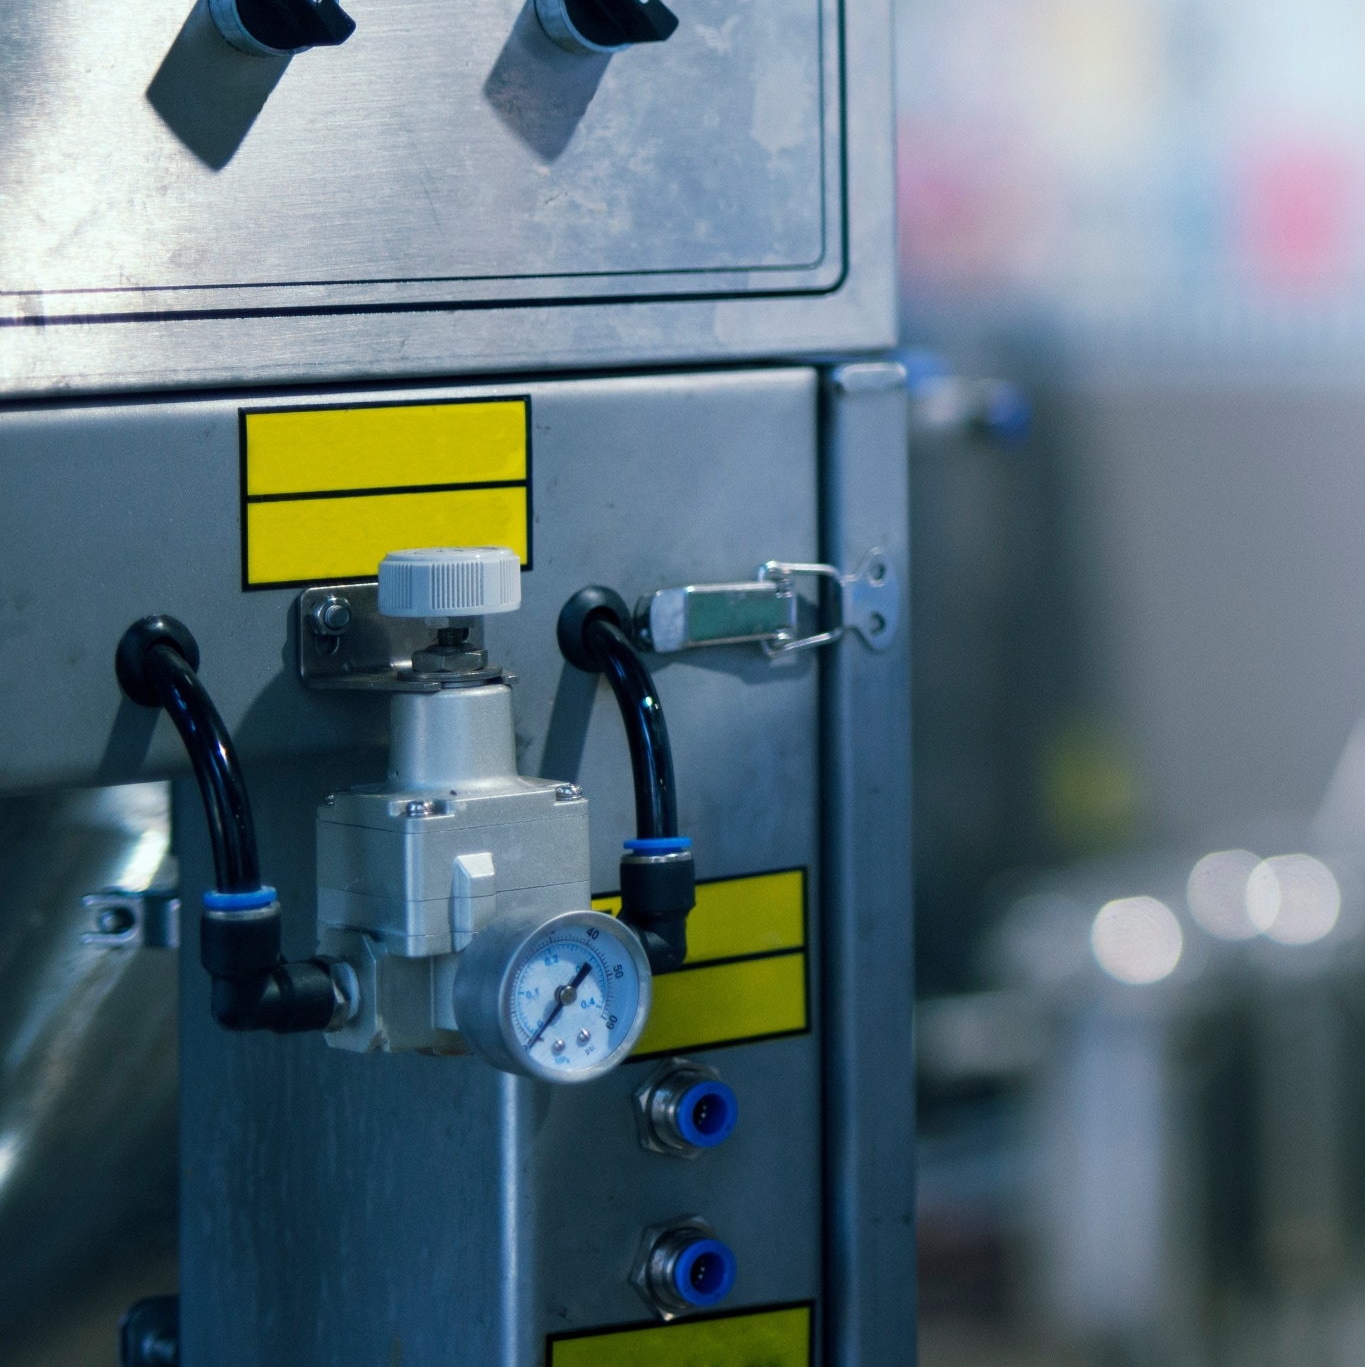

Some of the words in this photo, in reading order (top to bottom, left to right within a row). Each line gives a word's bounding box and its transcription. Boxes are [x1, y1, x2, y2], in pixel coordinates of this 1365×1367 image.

[586, 927, 600, 940] 40
[613, 964, 624, 979] 50
[581, 996, 596, 1009] 0.4
[606, 1015, 618, 1030] 60
